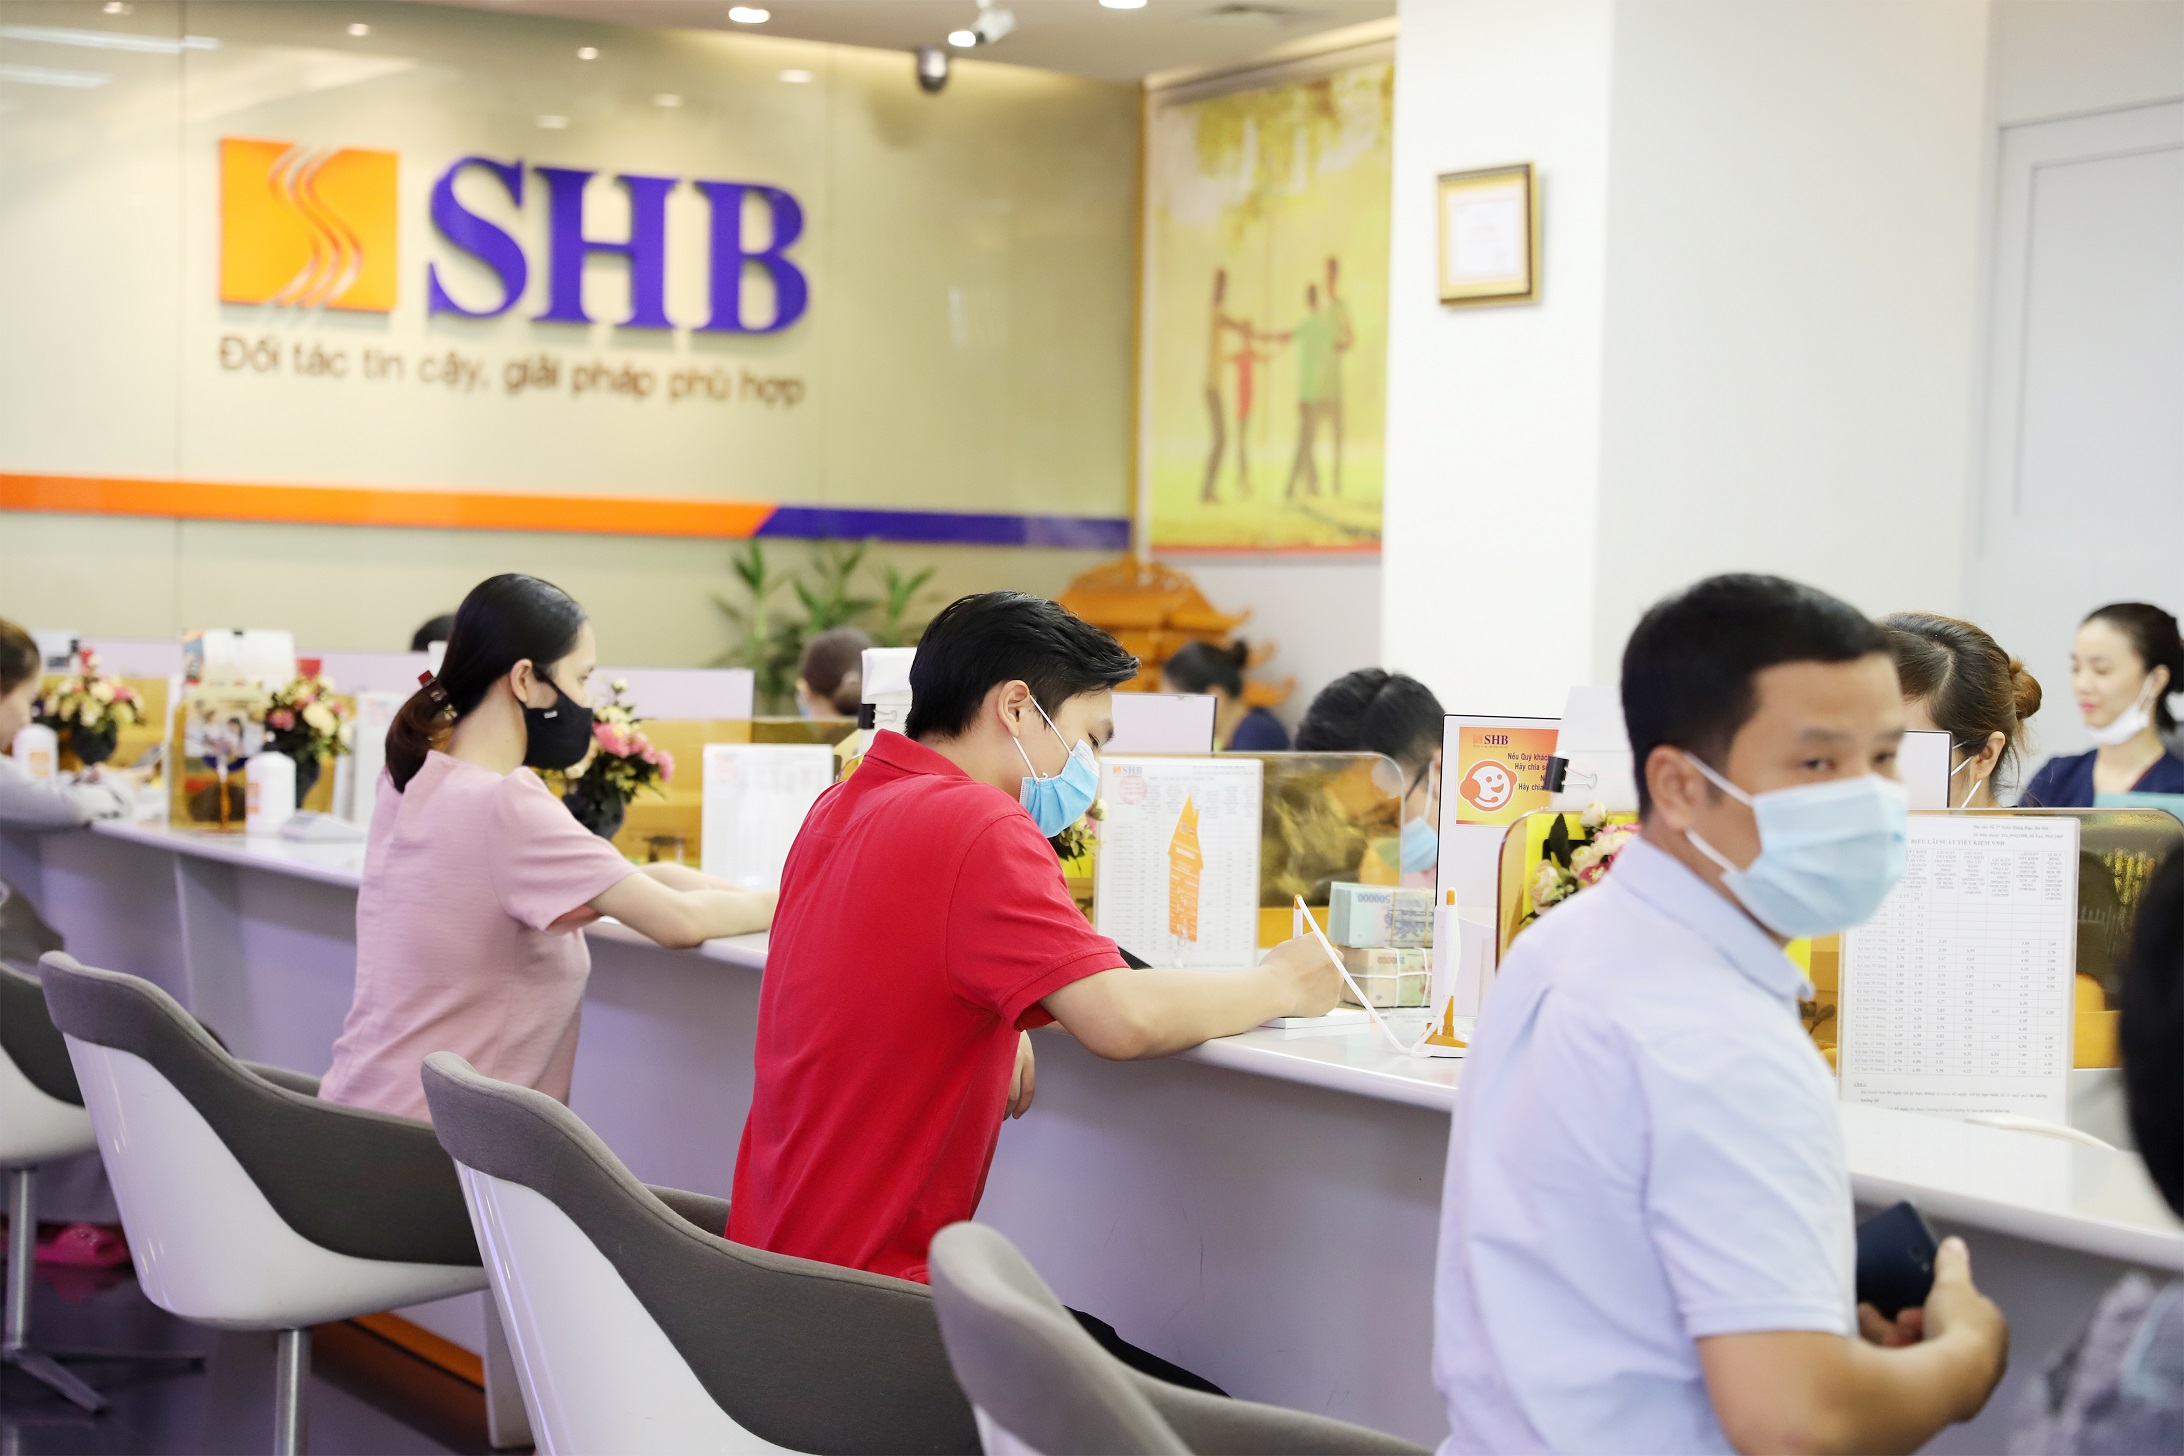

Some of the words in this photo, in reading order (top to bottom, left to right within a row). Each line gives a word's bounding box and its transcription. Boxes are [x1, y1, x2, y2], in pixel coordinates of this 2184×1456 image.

[428, 155, 810, 335] SHB
[219, 335, 281, 374] Đối
[293, 342, 350, 379] tác
[362, 347, 406, 382] tin
[571, 358, 655, 405] pháp
[667, 364, 731, 404] phù
[738, 367, 805, 409] hợp
[1484, 734, 1508, 745] SHB
[1358, 893, 1391, 904] 500000
